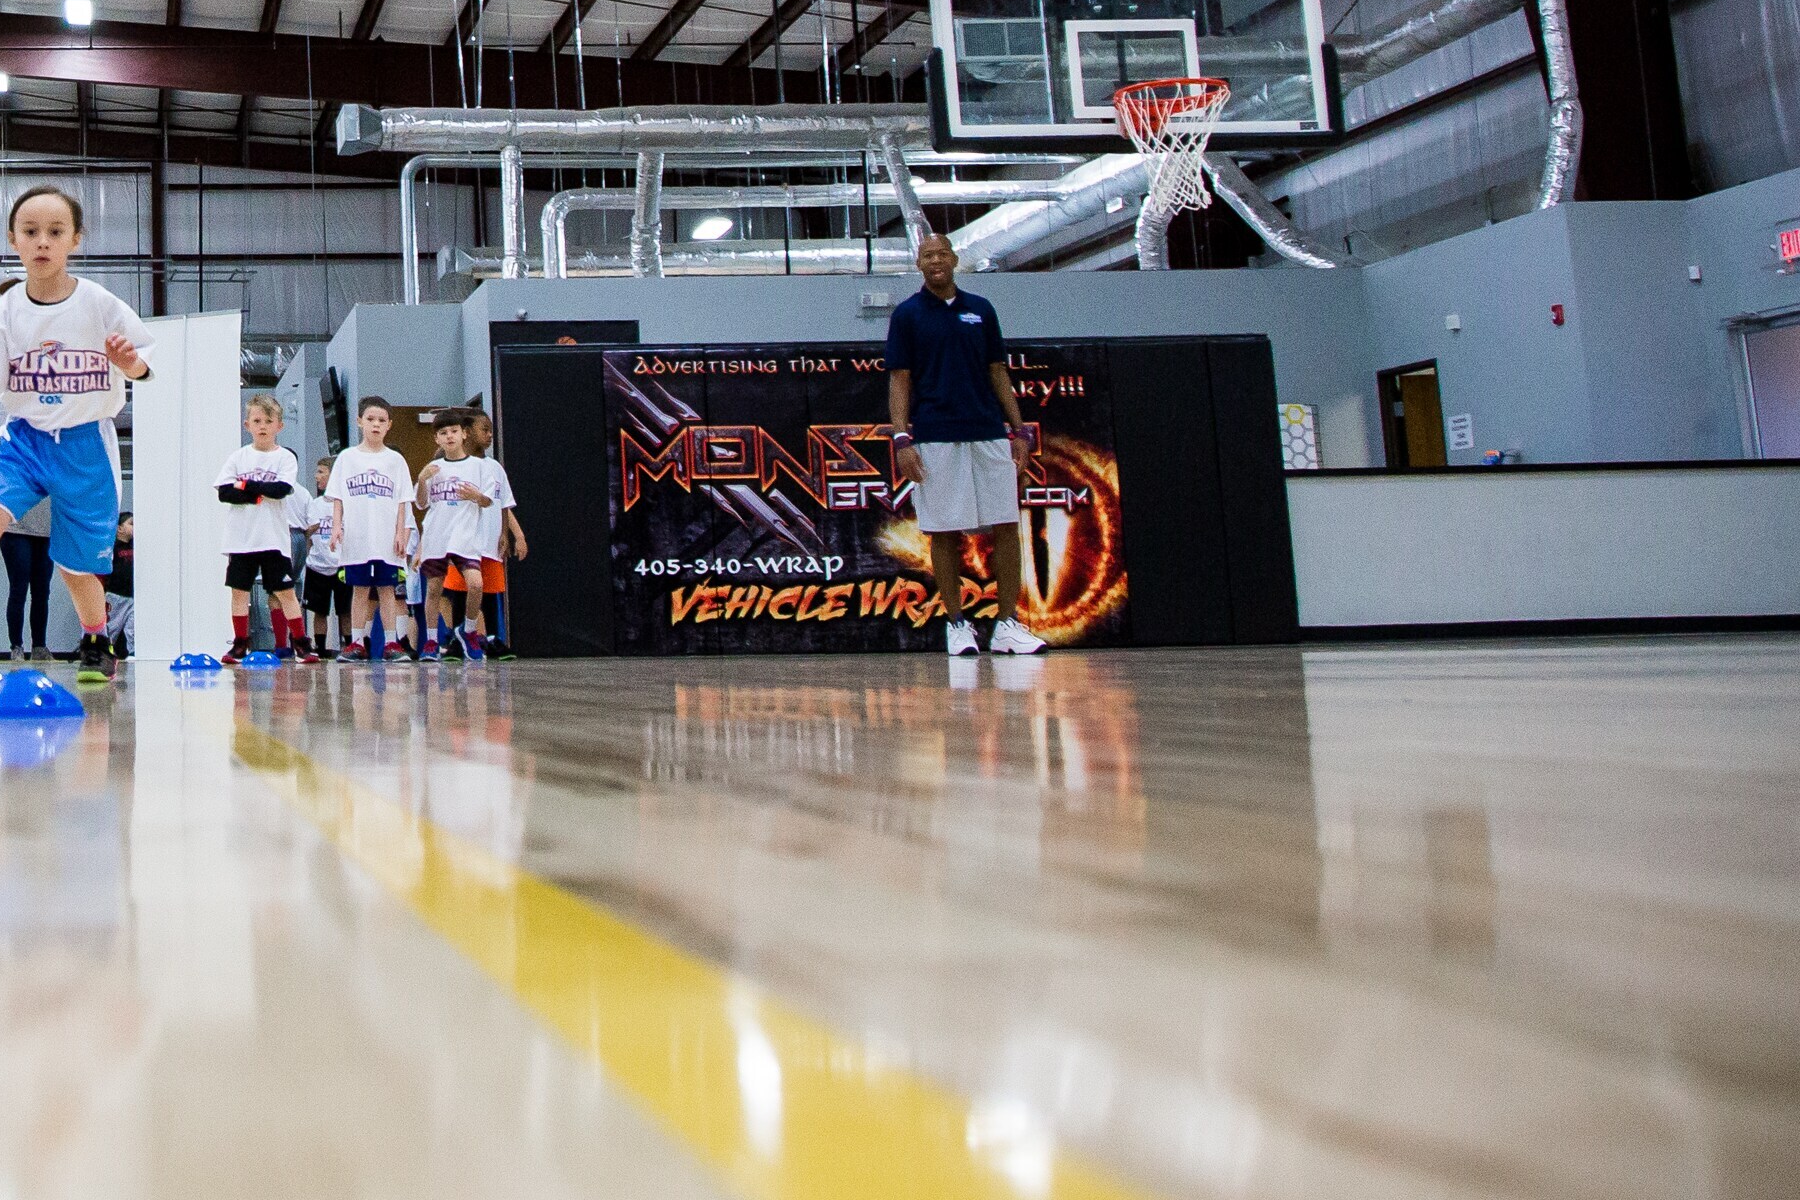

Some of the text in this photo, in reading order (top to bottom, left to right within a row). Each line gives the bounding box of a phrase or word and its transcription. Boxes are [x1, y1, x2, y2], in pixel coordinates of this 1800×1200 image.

[37, 374, 111, 393] BASKETBALL
[39, 394, 64, 404] COX
[671, 576, 855, 626] VEHICLE
